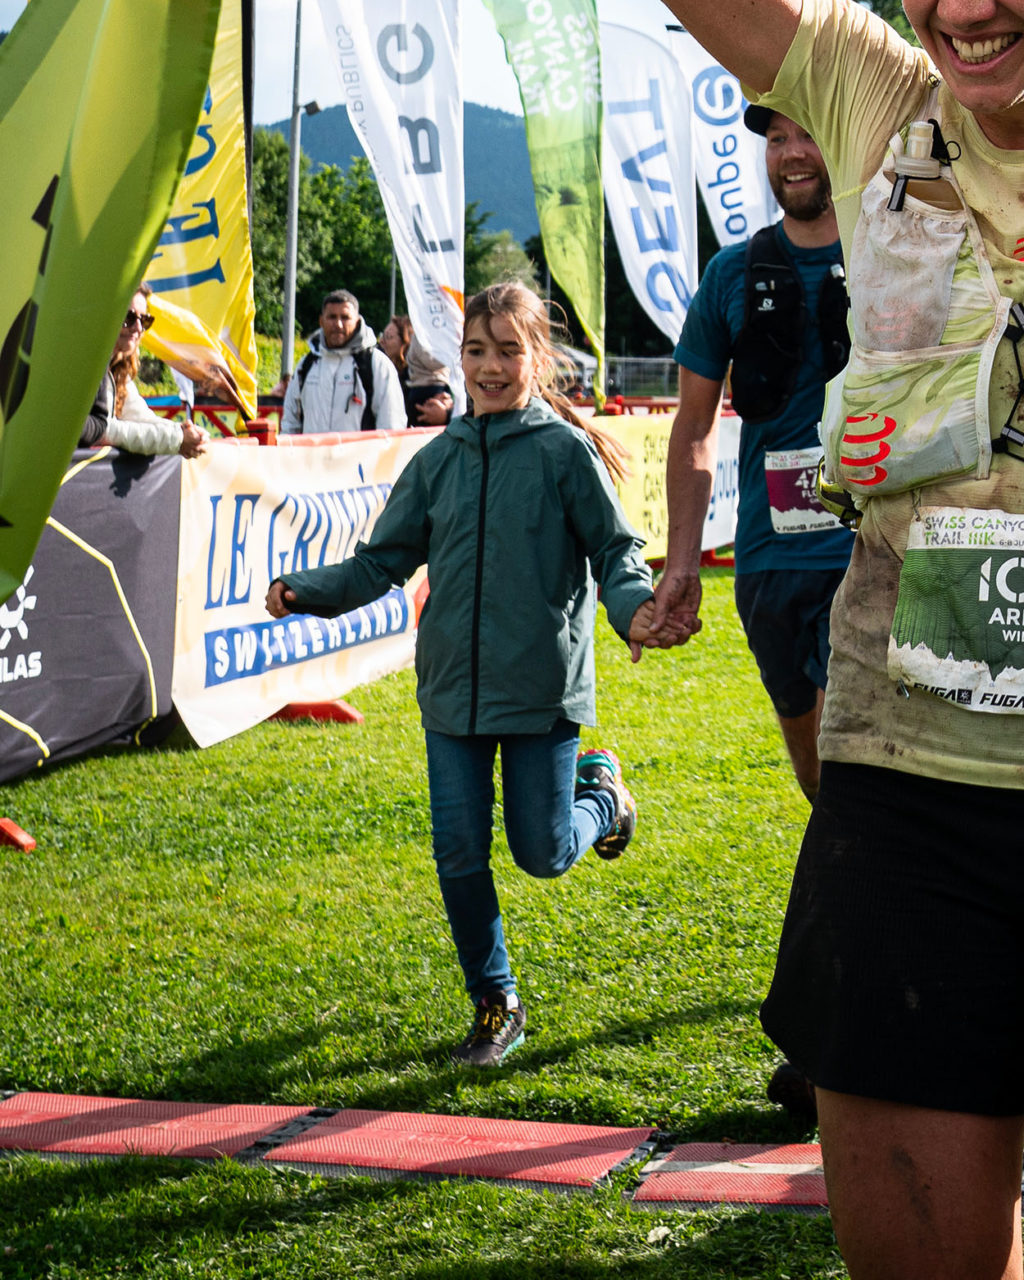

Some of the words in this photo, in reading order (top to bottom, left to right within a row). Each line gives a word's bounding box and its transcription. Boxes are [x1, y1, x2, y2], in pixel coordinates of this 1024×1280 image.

[925, 516, 966, 531] SWISS
[925, 531, 964, 546] TRAIL
[205, 494, 261, 610] LE
[214, 596, 403, 678] SWITZERLAND
